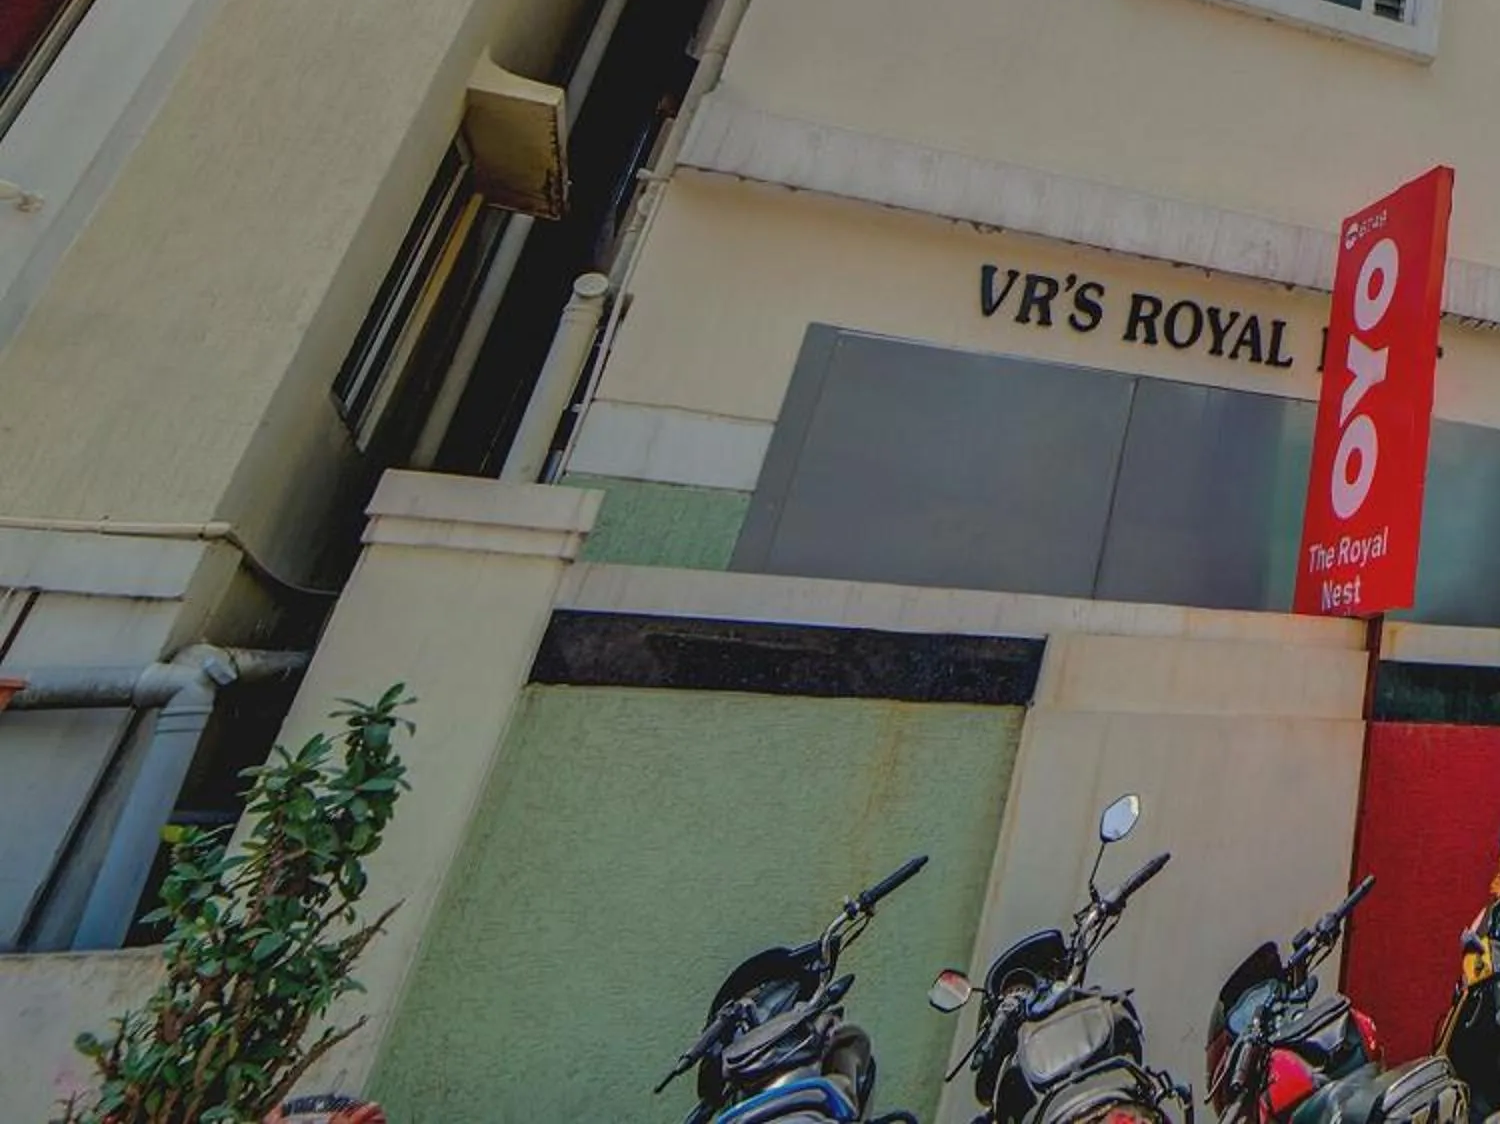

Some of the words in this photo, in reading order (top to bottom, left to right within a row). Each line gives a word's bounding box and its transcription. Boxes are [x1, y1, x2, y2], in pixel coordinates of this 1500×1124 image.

[981, 264, 1105, 333] VR'S
[1122, 293, 1294, 368] ROYAL
[1331, 237, 1399, 520] OYO
[1308, 543, 1336, 573] The
[1337, 525, 1389, 568] Royal
[1321, 574, 1362, 612] Nest
